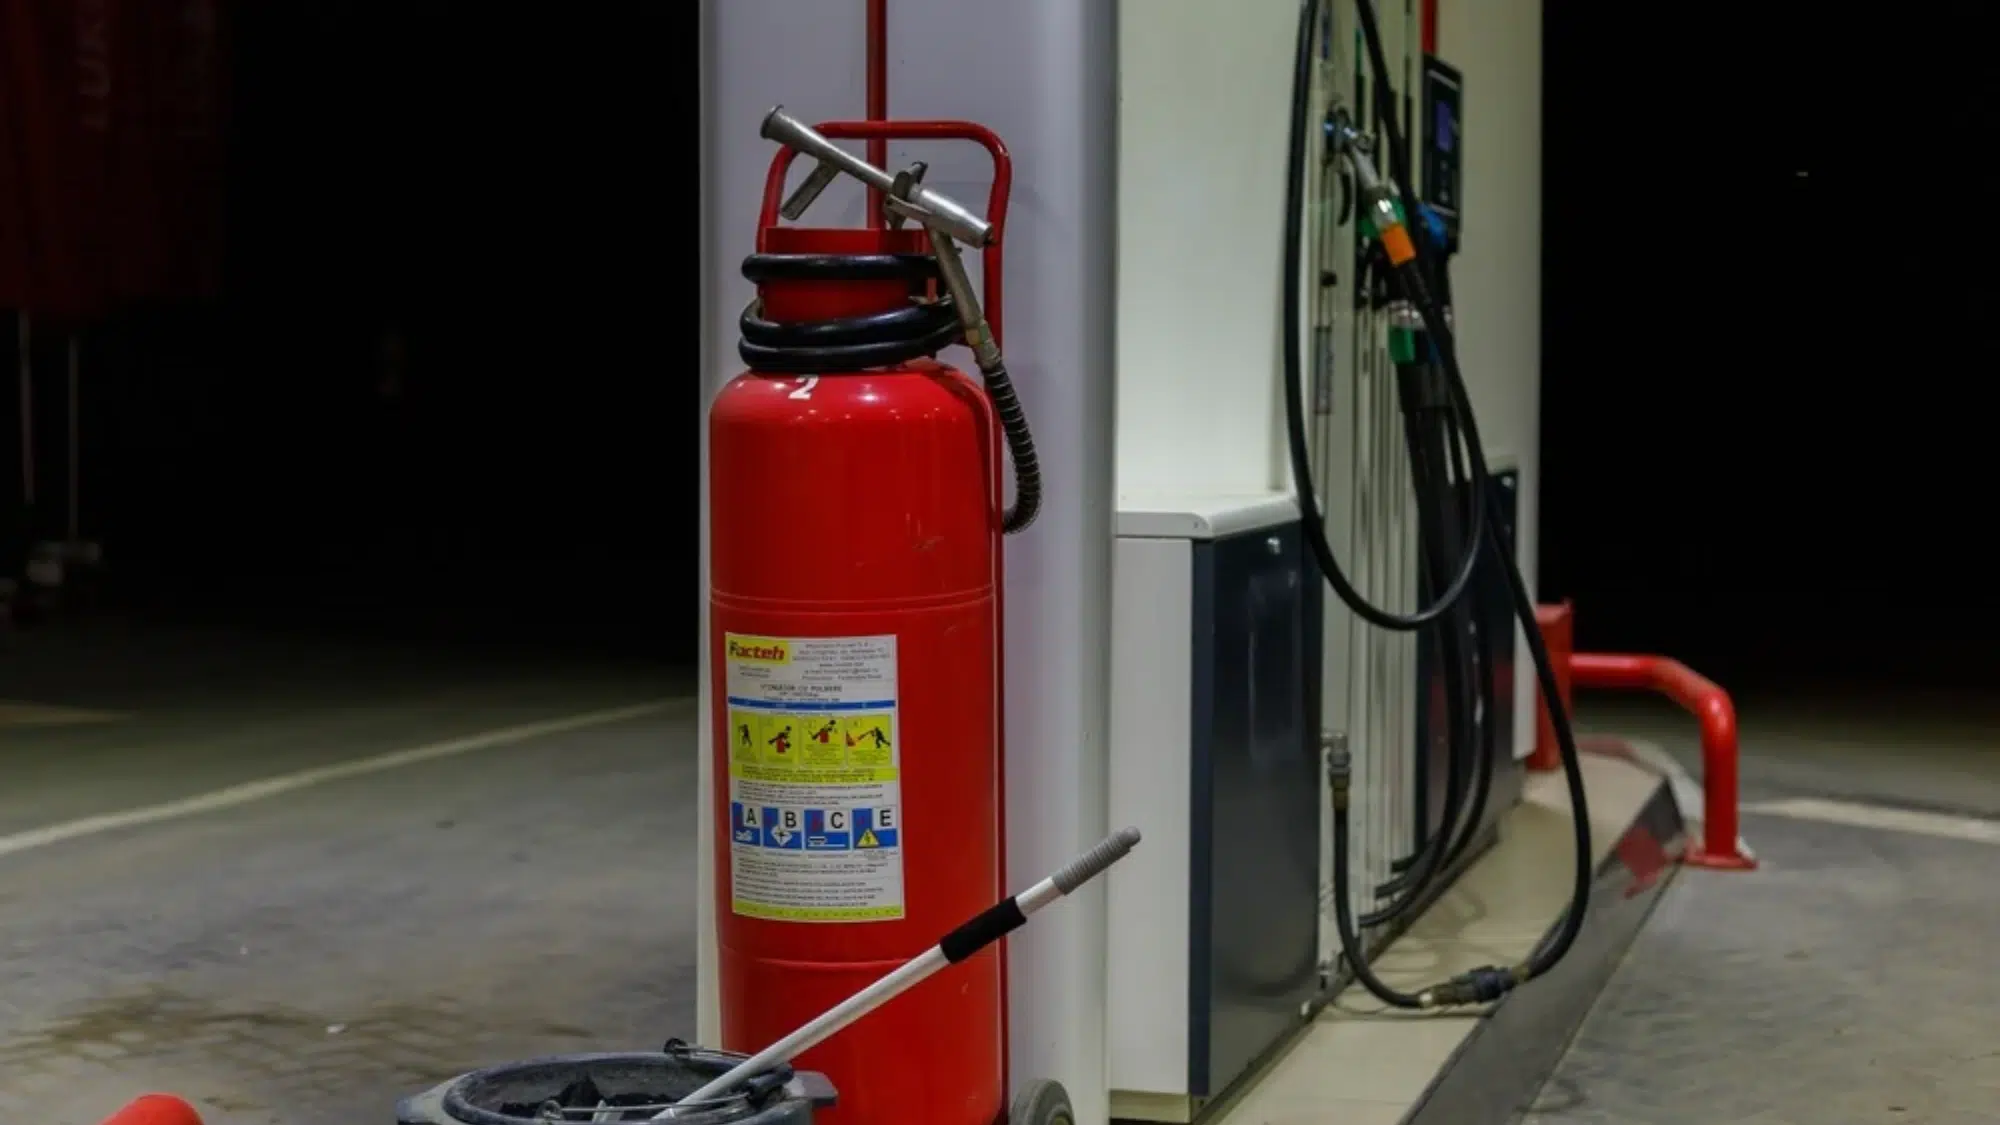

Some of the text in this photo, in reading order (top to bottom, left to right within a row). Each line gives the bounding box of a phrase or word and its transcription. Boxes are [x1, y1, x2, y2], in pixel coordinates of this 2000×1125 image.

[788, 375, 818, 399] 2
[729, 640, 785, 661] Facteh
[746, 808, 892, 828] A B C E
